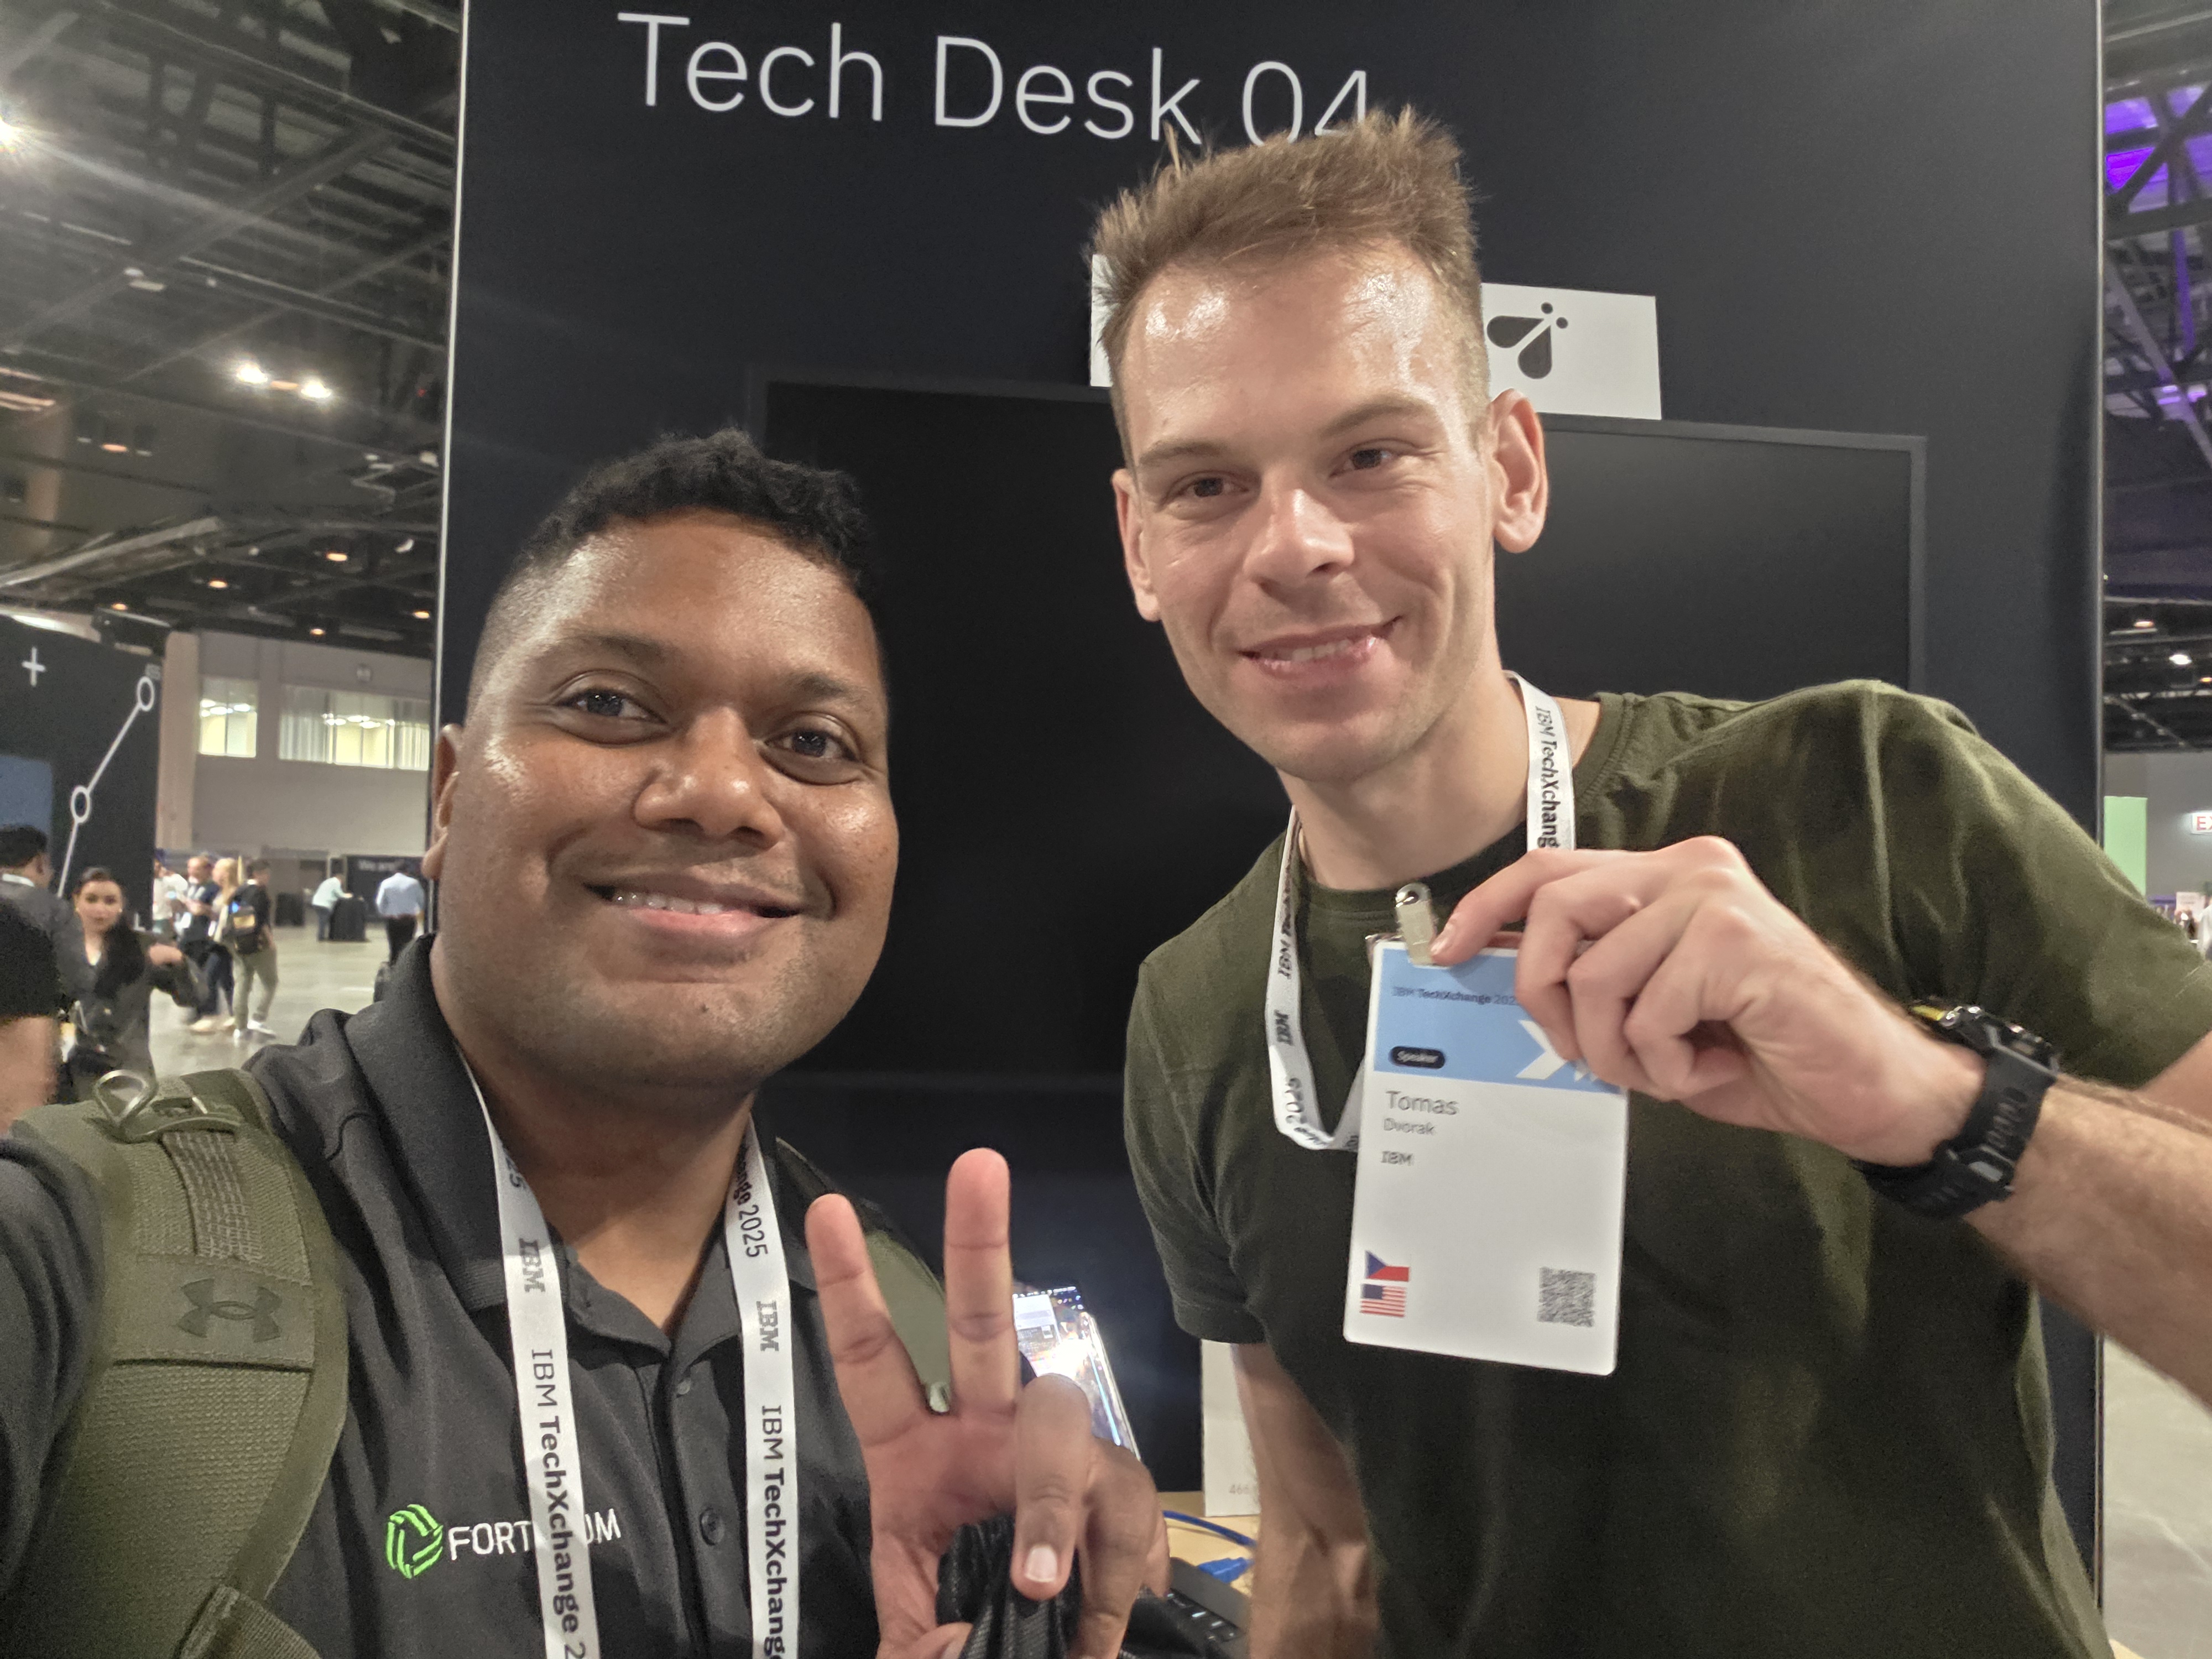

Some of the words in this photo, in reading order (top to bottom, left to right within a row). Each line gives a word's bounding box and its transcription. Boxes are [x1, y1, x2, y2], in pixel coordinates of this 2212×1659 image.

[617, 12, 883, 122] Tech
[935, 35, 1202, 145] Desk
[1243, 61, 1366, 147] 04
[1537, 740, 1561, 848] TechXchang
[1494, 995, 1516, 1006] 202
[1383, 1117, 1436, 1135] Dvorak
[1385, 1090, 1459, 1115] Tomas
[1381, 1150, 1413, 1166] IBM
[738, 1204, 768, 1258] 2025
[519, 1238, 546, 1293] IBM
[756, 1301, 779, 1352] IBM
[531, 1349, 559, 1407] IBM
[761, 1405, 784, 1460] IBM
[539, 1415, 580, 1634] TechXchange
[764, 1467, 788, 1659] TechXchang
